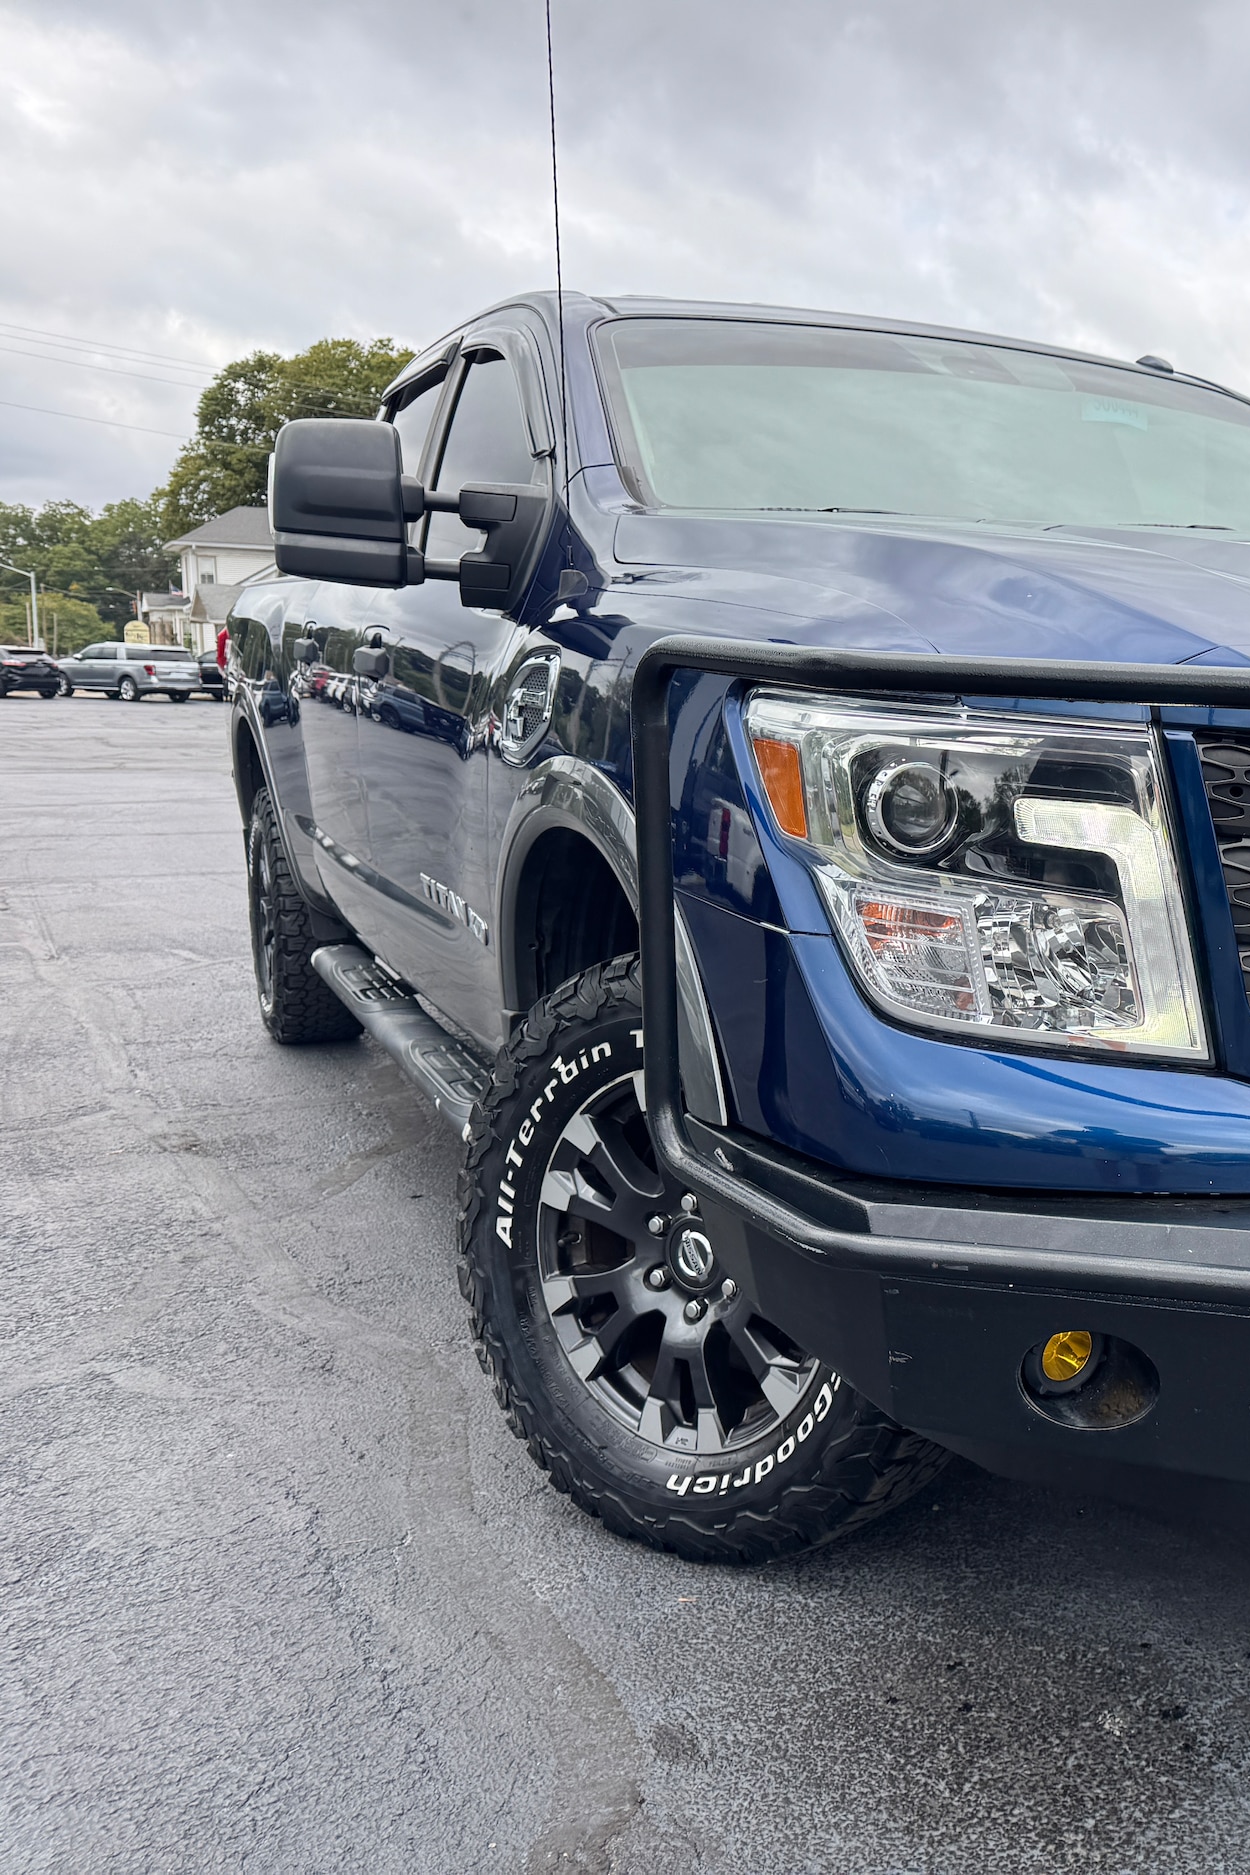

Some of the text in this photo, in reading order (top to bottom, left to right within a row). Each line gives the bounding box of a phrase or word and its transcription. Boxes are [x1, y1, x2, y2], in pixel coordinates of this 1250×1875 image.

[420, 872, 469, 927] TITAN
[495, 1041, 612, 1249] All-Terrain
[666, 1372, 841, 1496] Goodrich
